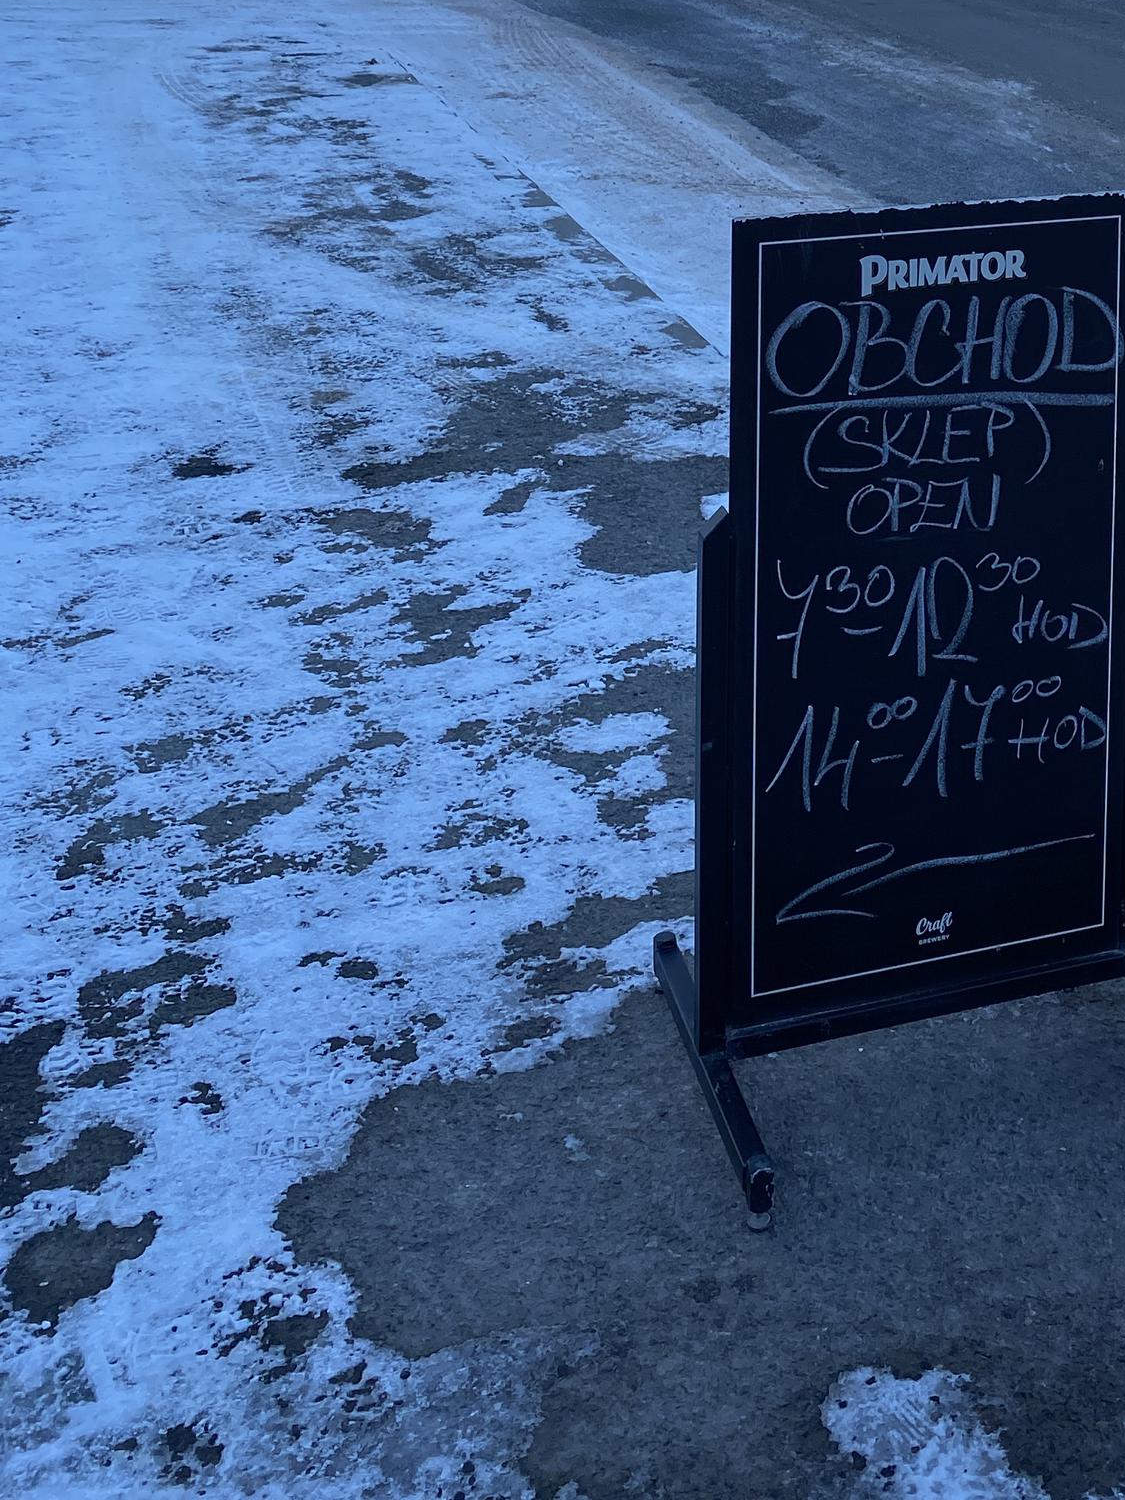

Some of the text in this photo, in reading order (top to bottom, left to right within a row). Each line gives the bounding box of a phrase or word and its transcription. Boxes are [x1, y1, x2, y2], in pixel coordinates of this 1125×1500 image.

[766, 286, 1125, 397] OBCHOD
[803, 400, 1051, 490] (SKLEP)
[846, 474, 1001, 536] OPEN
[1011, 595, 1109, 649] HOD
[1008, 706, 1107, 764] HOD
[915, 911, 953, 936] Craft
